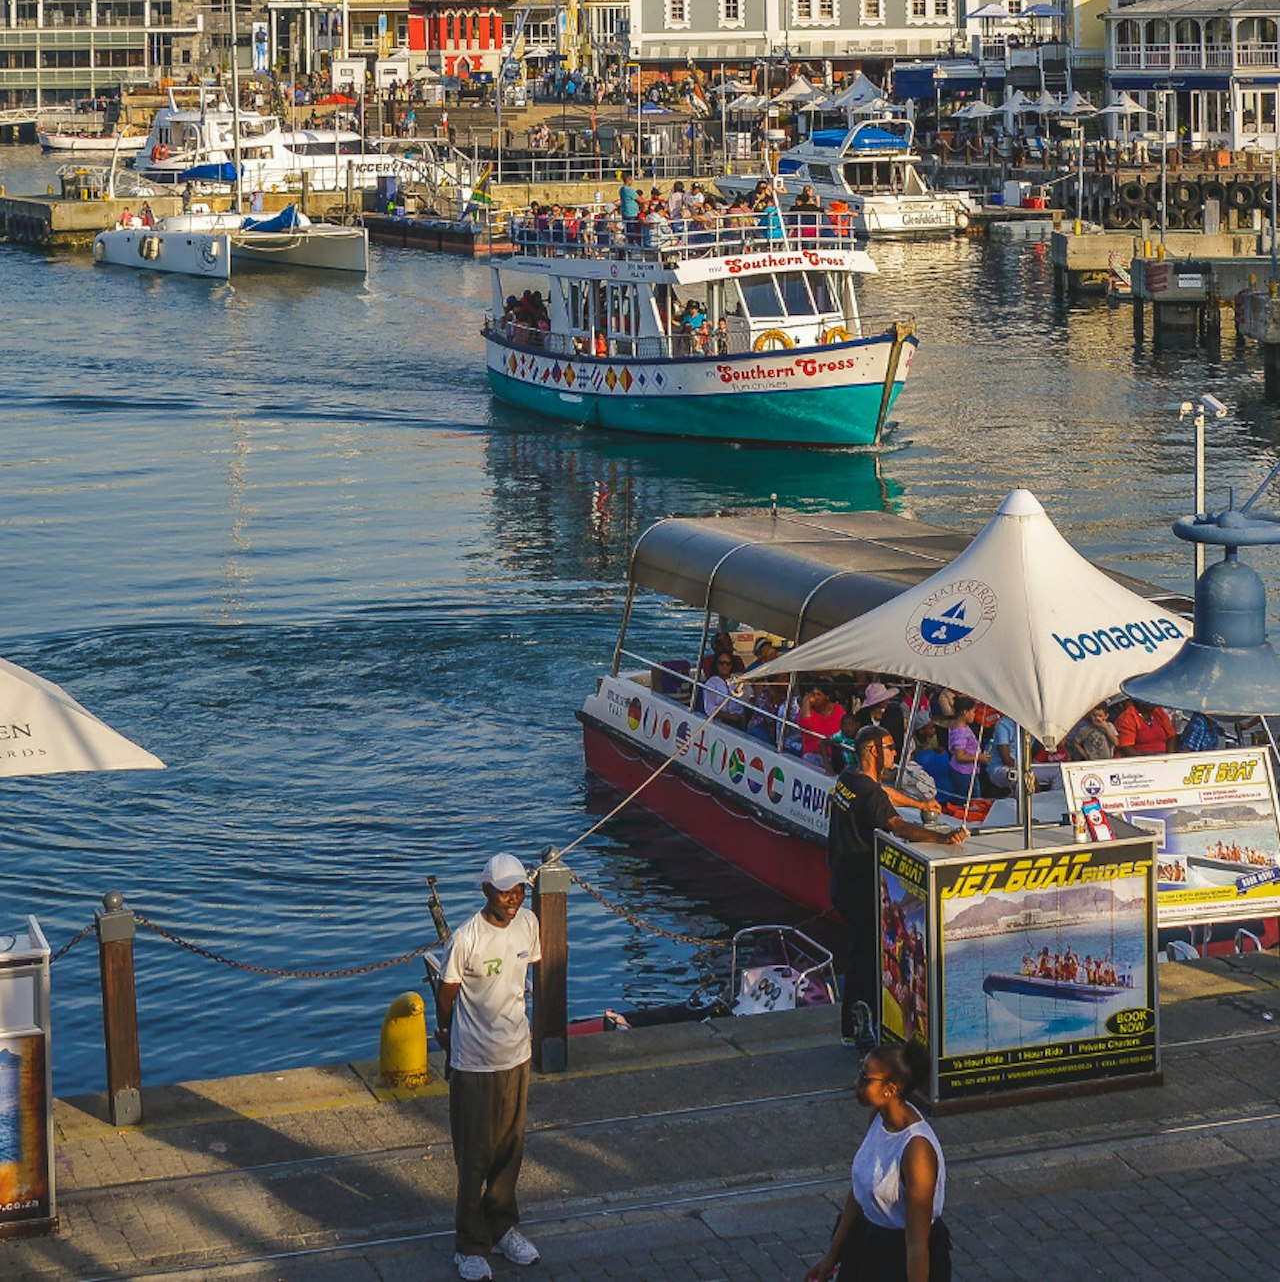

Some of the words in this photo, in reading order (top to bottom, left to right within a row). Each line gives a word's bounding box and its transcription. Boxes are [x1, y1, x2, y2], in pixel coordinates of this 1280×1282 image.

[724, 254, 803, 273] Southern
[803, 251, 845, 266] Cross
[717, 365, 795, 383] Southern
[795, 358, 854, 377] Cross
[922, 579, 996, 623] WATERFRONT
[906, 626, 973, 657] CHARTERS
[1052, 618, 1184, 661] bonaqua
[1183, 764, 1214, 785] JET
[1215, 760, 1258, 783] BOAT
[880, 846, 900, 868] JET
[899, 854, 926, 884] BOAT
[941, 862, 1008, 899] JET
[1003, 853, 1093, 893] BOAT
[1080, 860, 1153, 884] RIDES
[1116, 1010, 1148, 1024] BOOK
[1120, 1021, 1145, 1034] NOW
[964, 1058, 984, 1068] Hour
[985, 1055, 1004, 1065] Ride
[1023, 1050, 1044, 1060] Hour
[1044, 1047, 1064, 1057] Ride
[1078, 1042, 1106, 1053] Private
